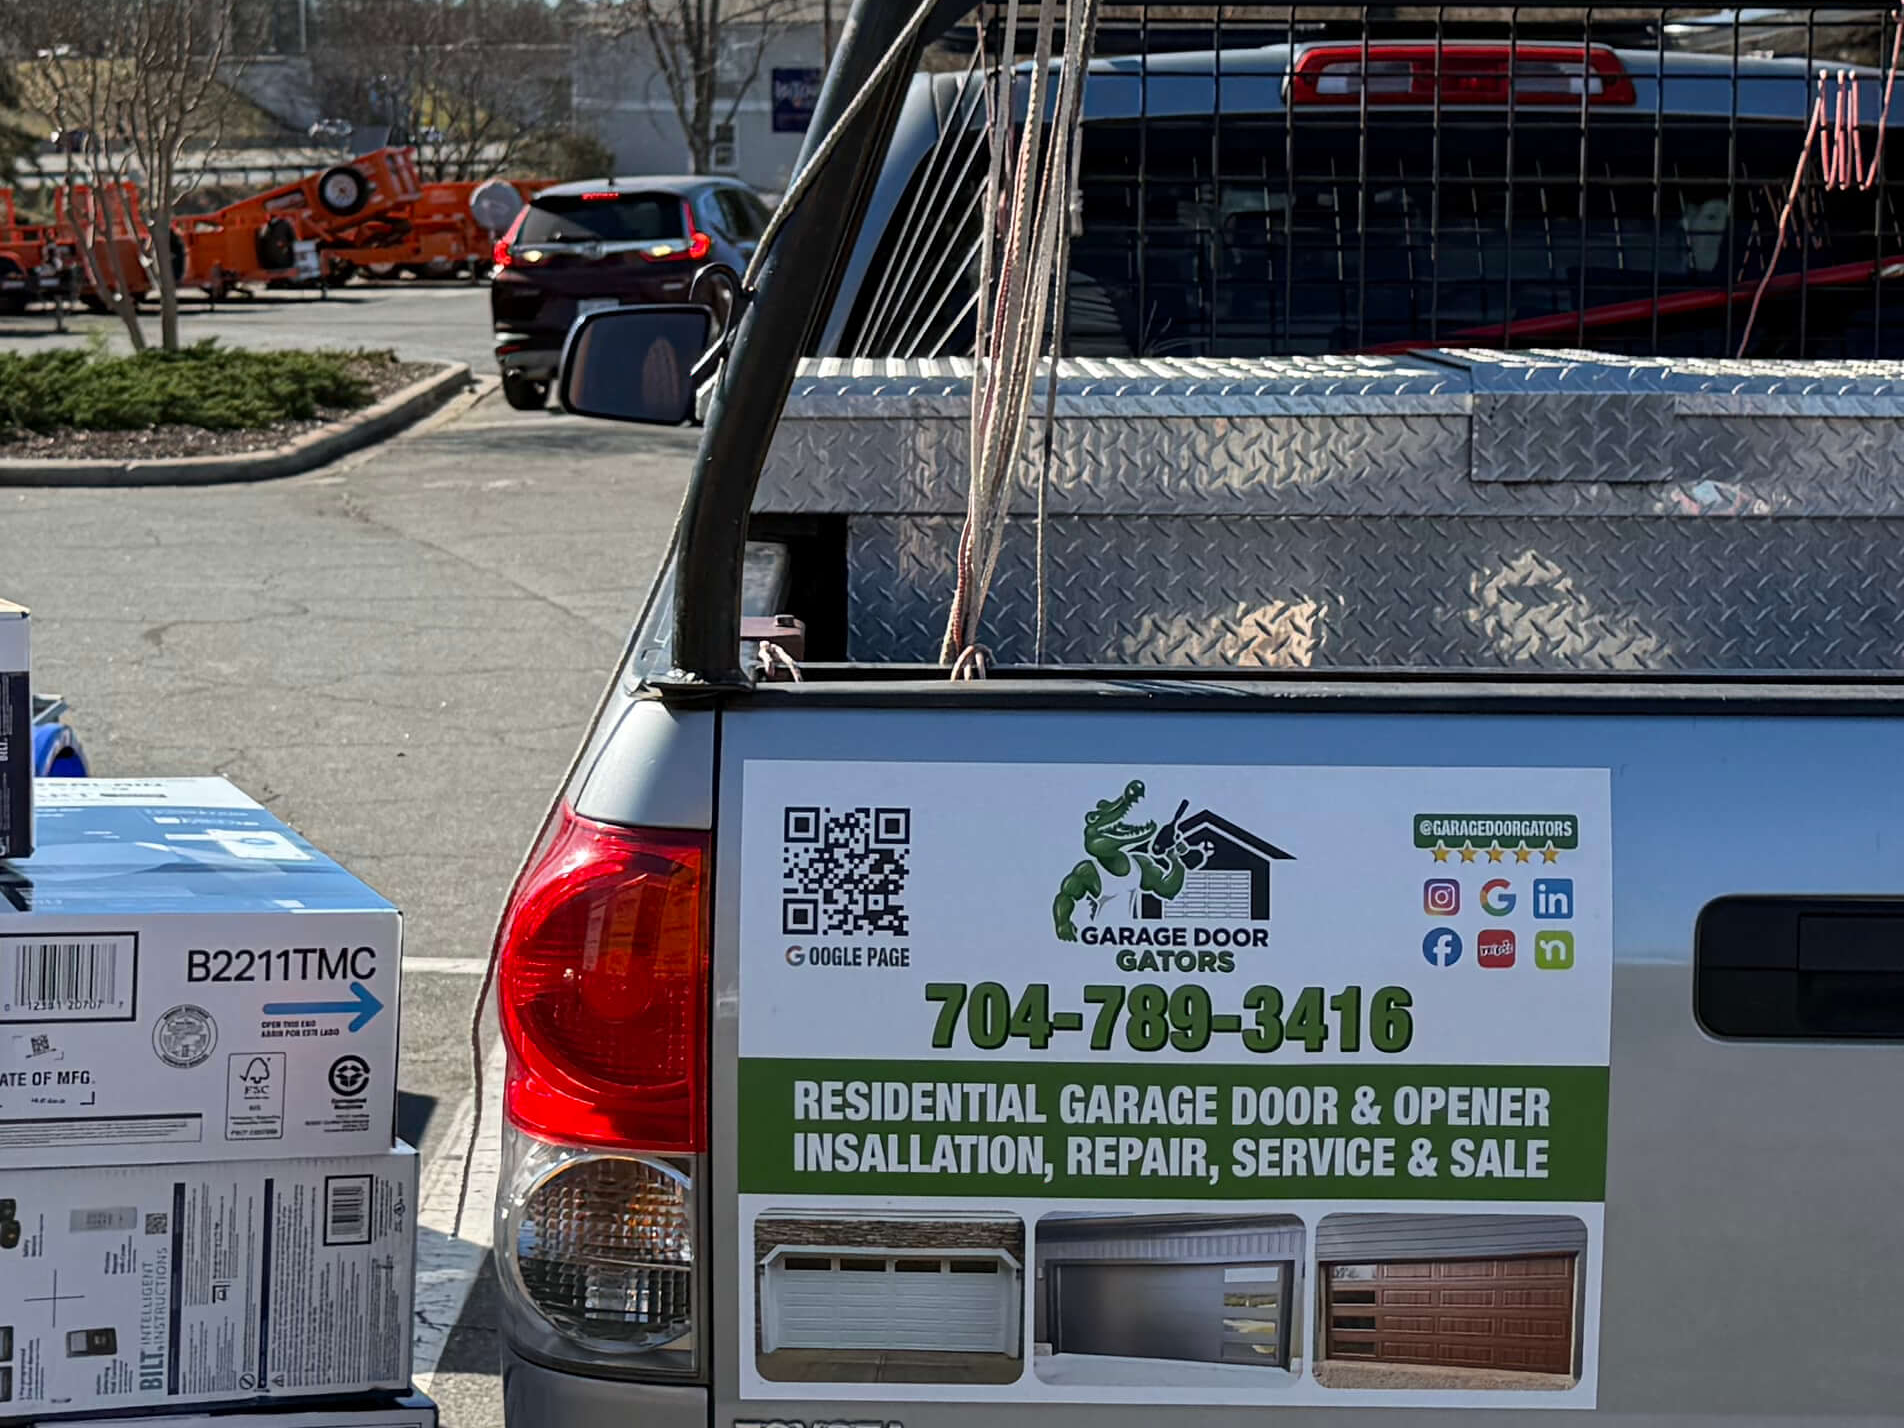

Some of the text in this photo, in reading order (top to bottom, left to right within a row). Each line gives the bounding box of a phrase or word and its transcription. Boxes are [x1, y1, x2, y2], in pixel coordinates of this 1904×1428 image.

[1418, 818, 1573, 839] @GARAGEDOORGATORS
[1081, 926, 1269, 947] GARAGE DOOR
[187, 946, 377, 983] B2211TMC
[867, 947, 910, 968] PAGE
[1116, 950, 1236, 973] GATORS
[925, 982, 1415, 1053] 704-789-3416
[32, 1072, 52, 1086] OF
[57, 1071, 95, 1085] MFG.
[794, 1080, 1550, 1128] RESIDENTIAL GARAGE DOOR & OPENER
[794, 1131, 1550, 1184] INSALLATION, REPAIR, SERVICE & SALE
[140, 1261, 154, 1345] INTELLIGENT
[154, 1247, 168, 1345] INSTRUCTIONS
